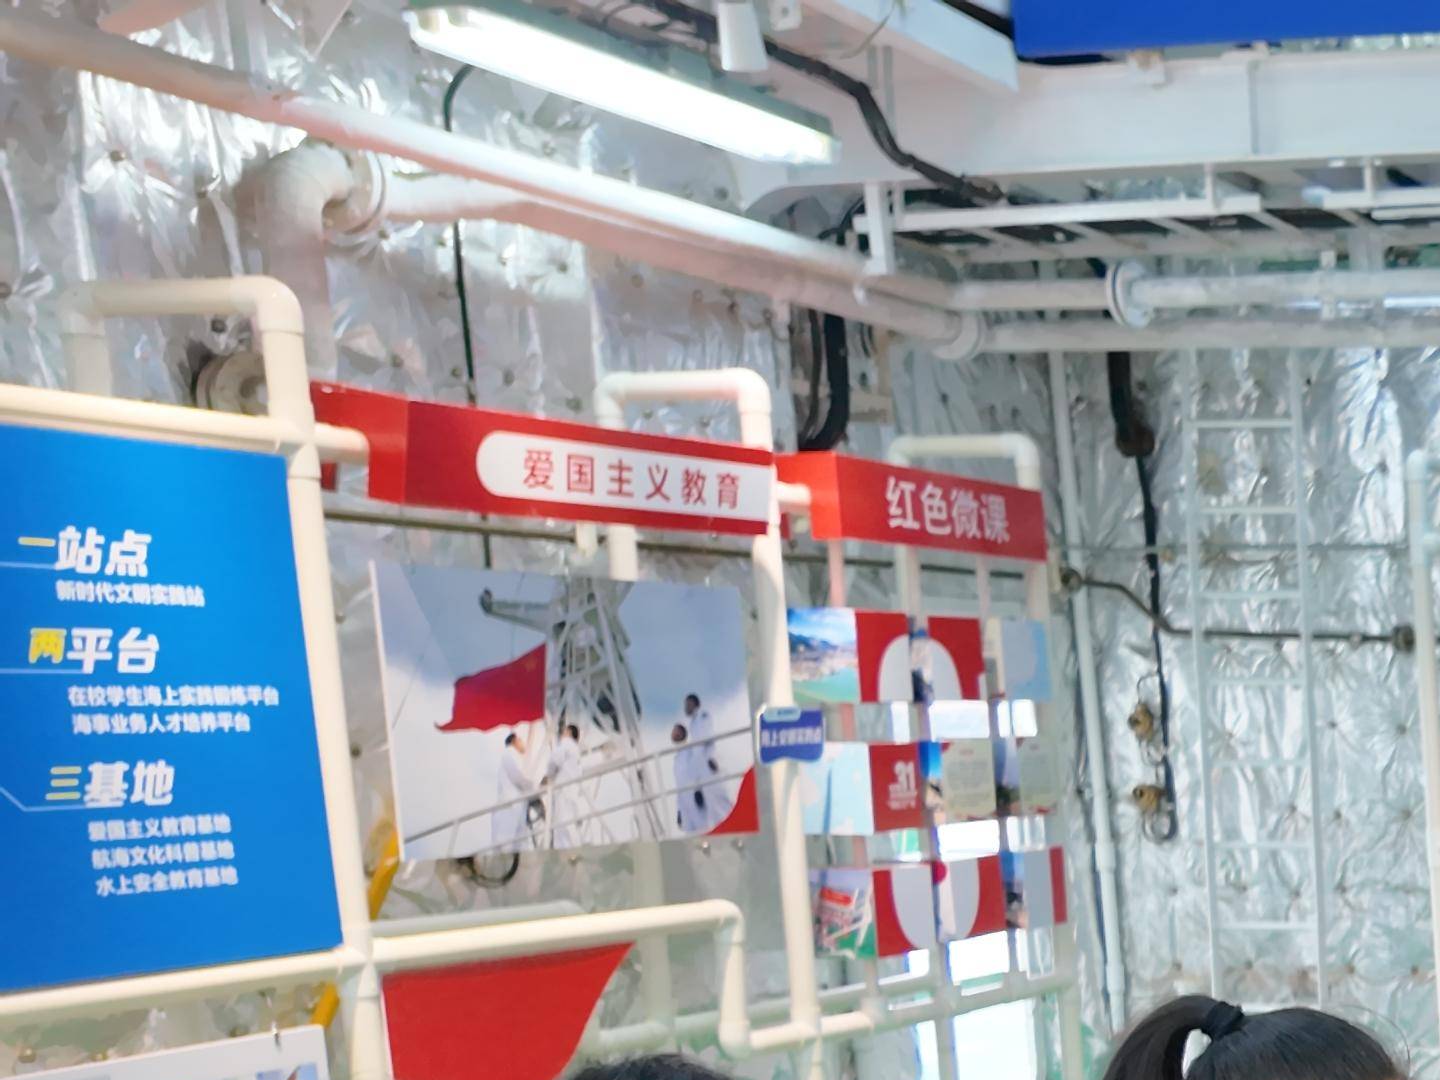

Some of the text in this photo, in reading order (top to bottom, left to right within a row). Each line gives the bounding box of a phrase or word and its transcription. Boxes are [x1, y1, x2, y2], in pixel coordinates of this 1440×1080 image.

[523, 448, 740, 510] 爱国主义教育
[886, 475, 1010, 544] 红色微课
[18, 525, 152, 577] 一站点
[28, 627, 160, 674] 两平台
[45, 759, 175, 808] 三基地
